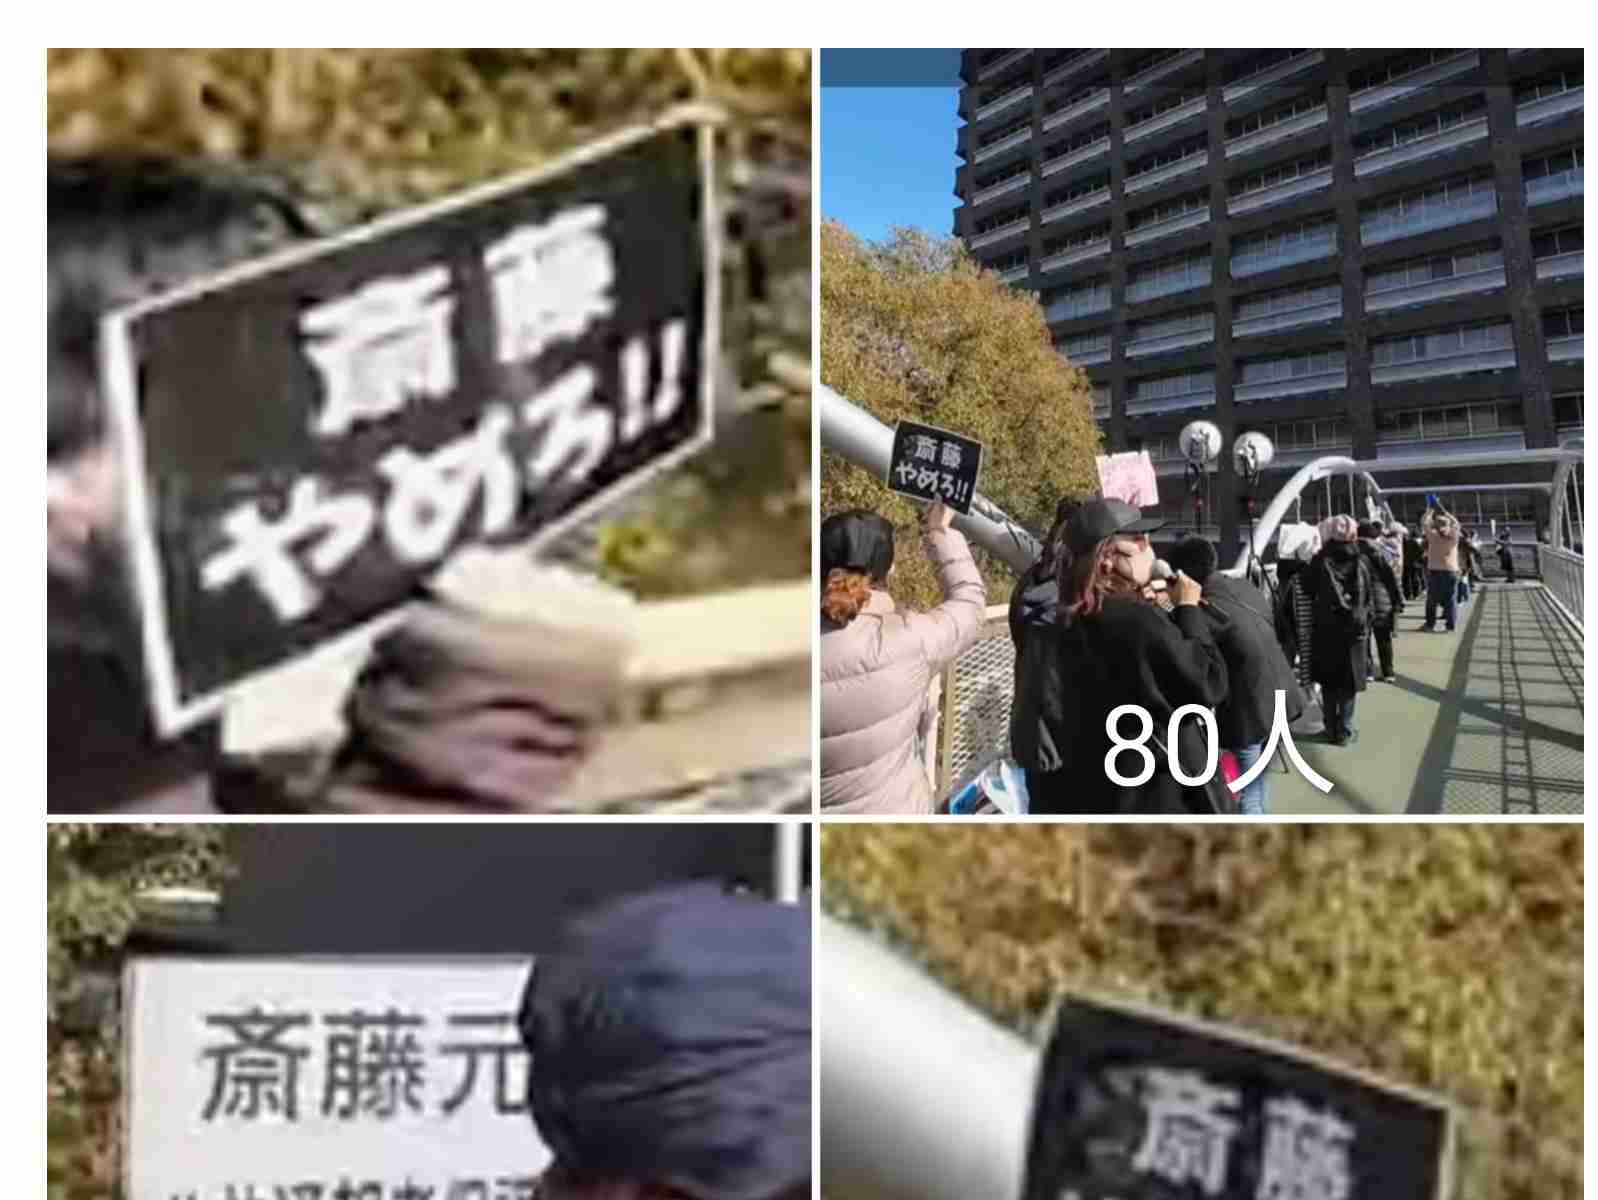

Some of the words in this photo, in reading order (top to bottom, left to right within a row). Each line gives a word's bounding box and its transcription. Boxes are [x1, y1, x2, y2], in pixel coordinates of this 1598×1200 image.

[302, 203, 614, 436] 斎藤
[200, 1006, 530, 1122] 斎藤元
